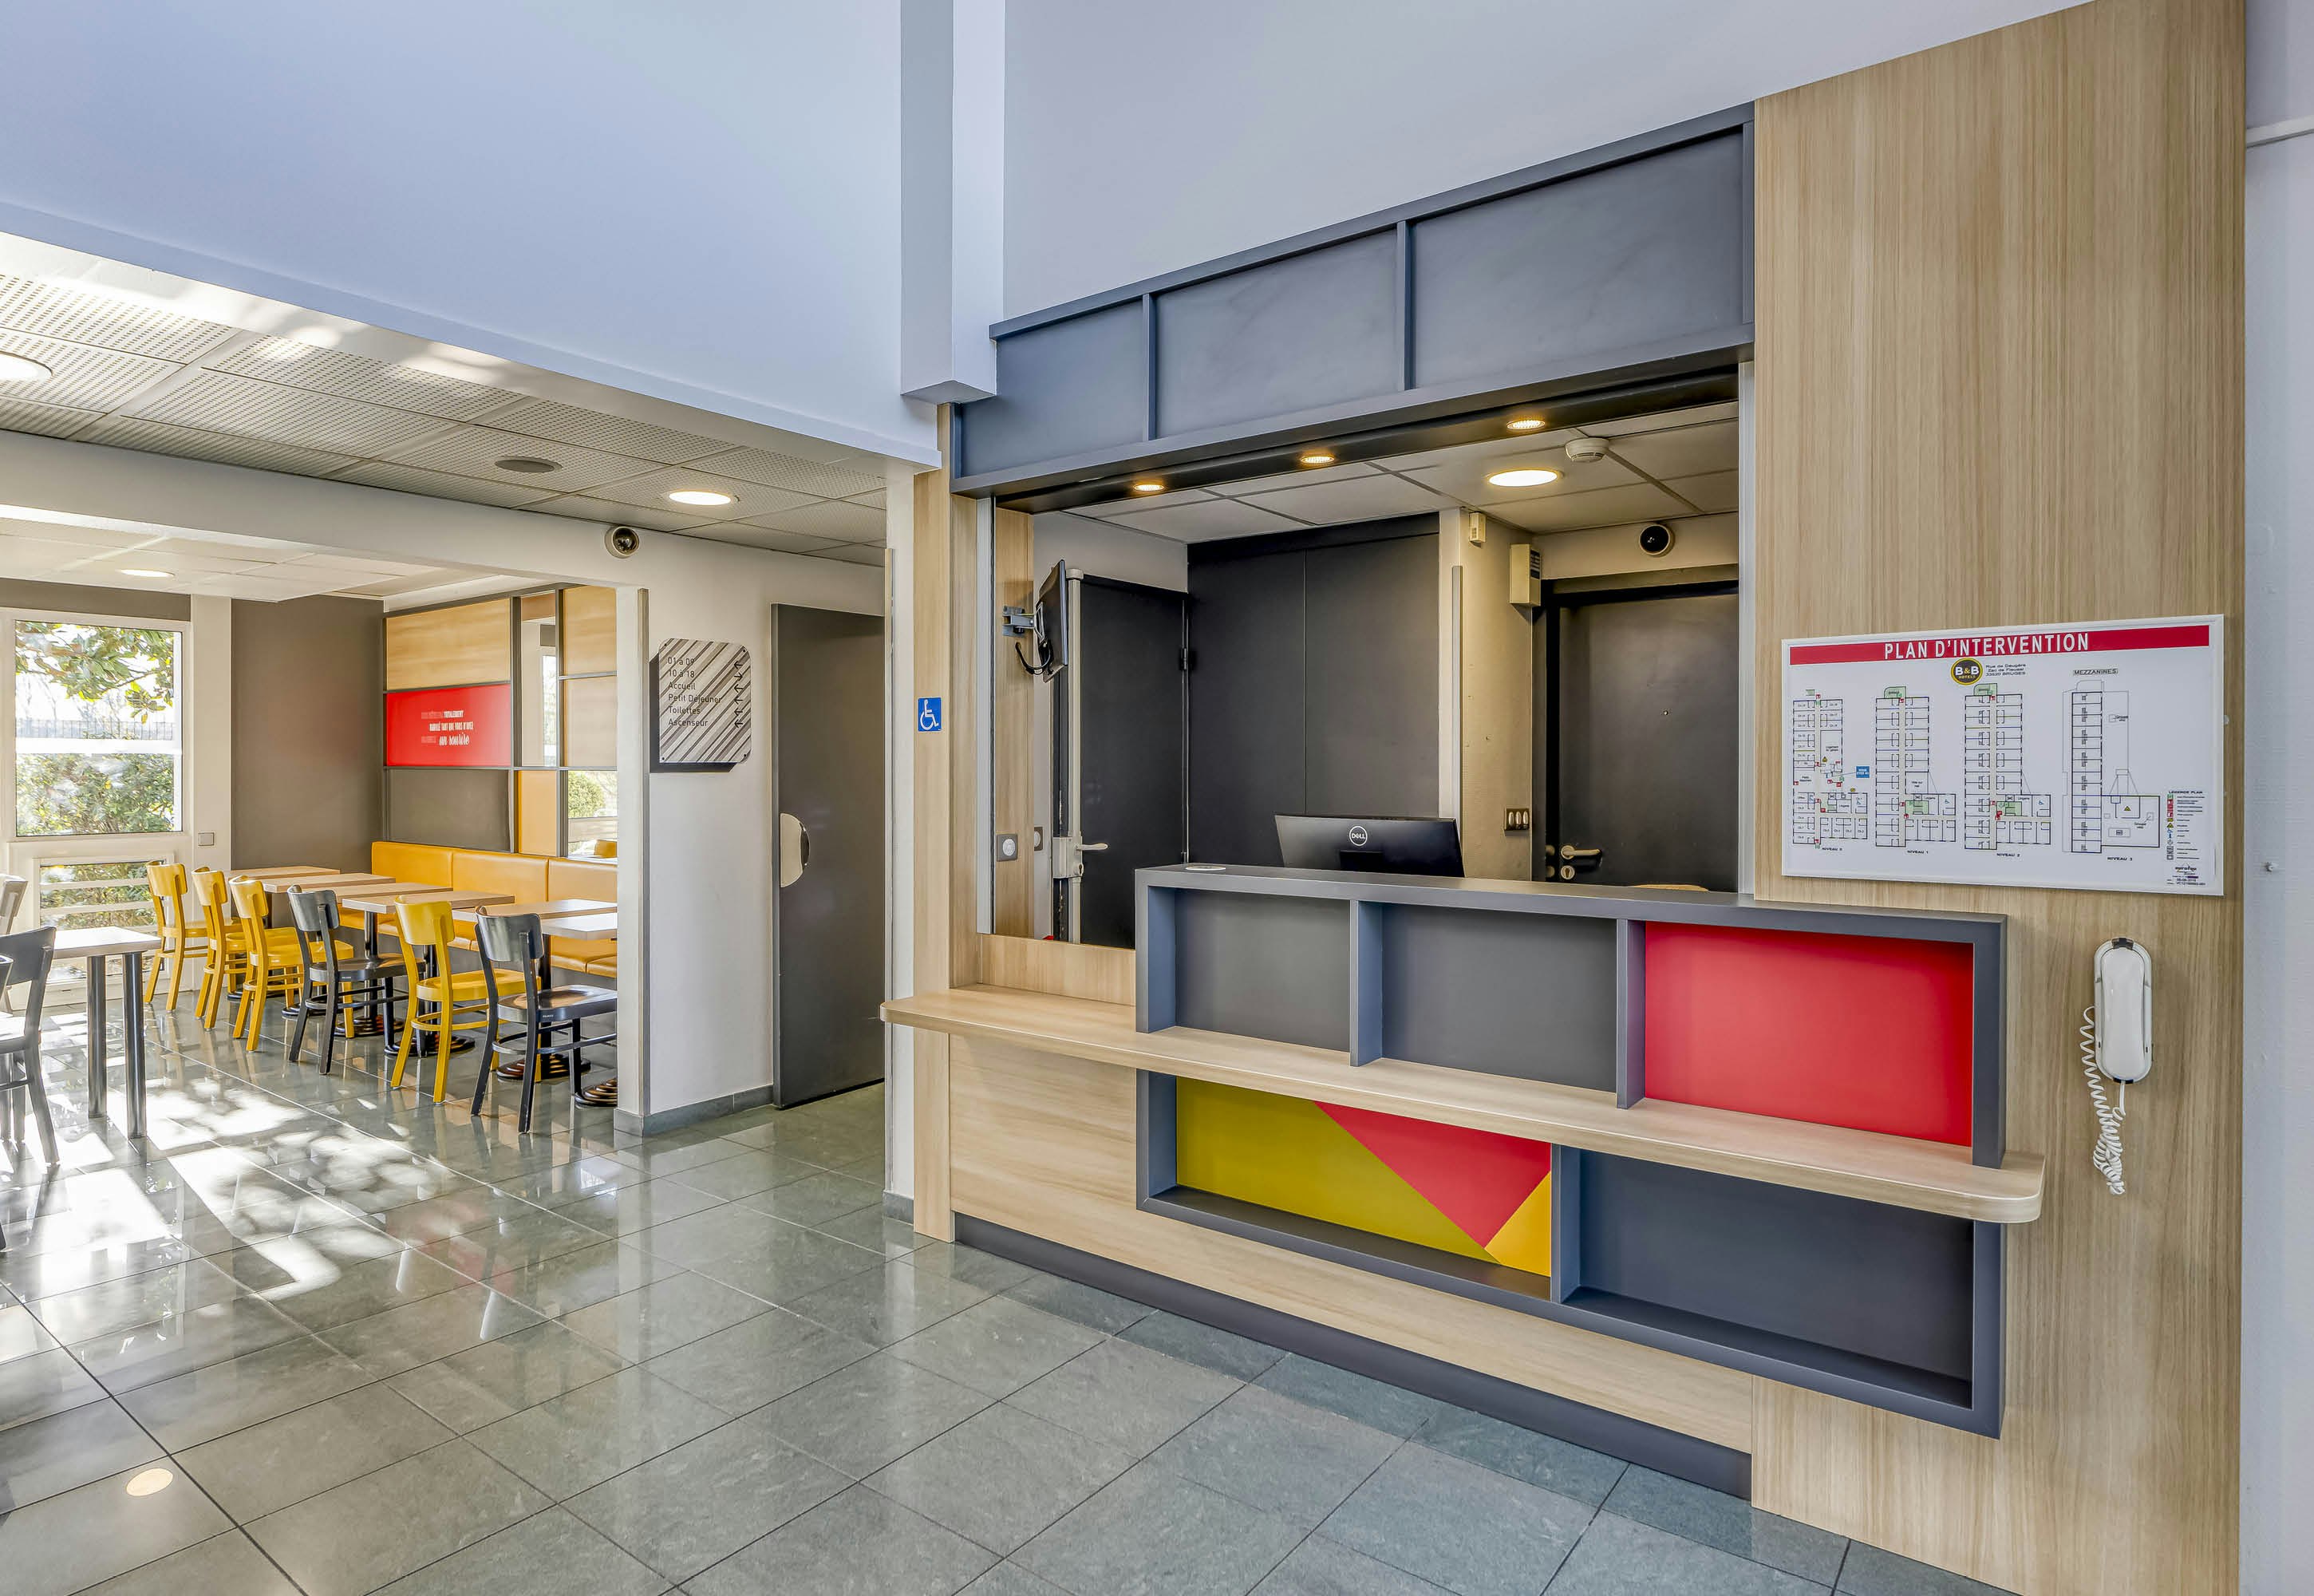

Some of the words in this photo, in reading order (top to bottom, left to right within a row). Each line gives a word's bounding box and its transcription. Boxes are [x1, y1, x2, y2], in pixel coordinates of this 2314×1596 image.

[1884, 641, 1928, 660] PLAN
[1935, 633, 2089, 658] D'INTERVENTION
[1955, 666, 1980, 676] B&B
[669, 681, 696, 690] Accueil
[688, 694, 721, 704] Déjeuner
[669, 705, 701, 714] Toilettes
